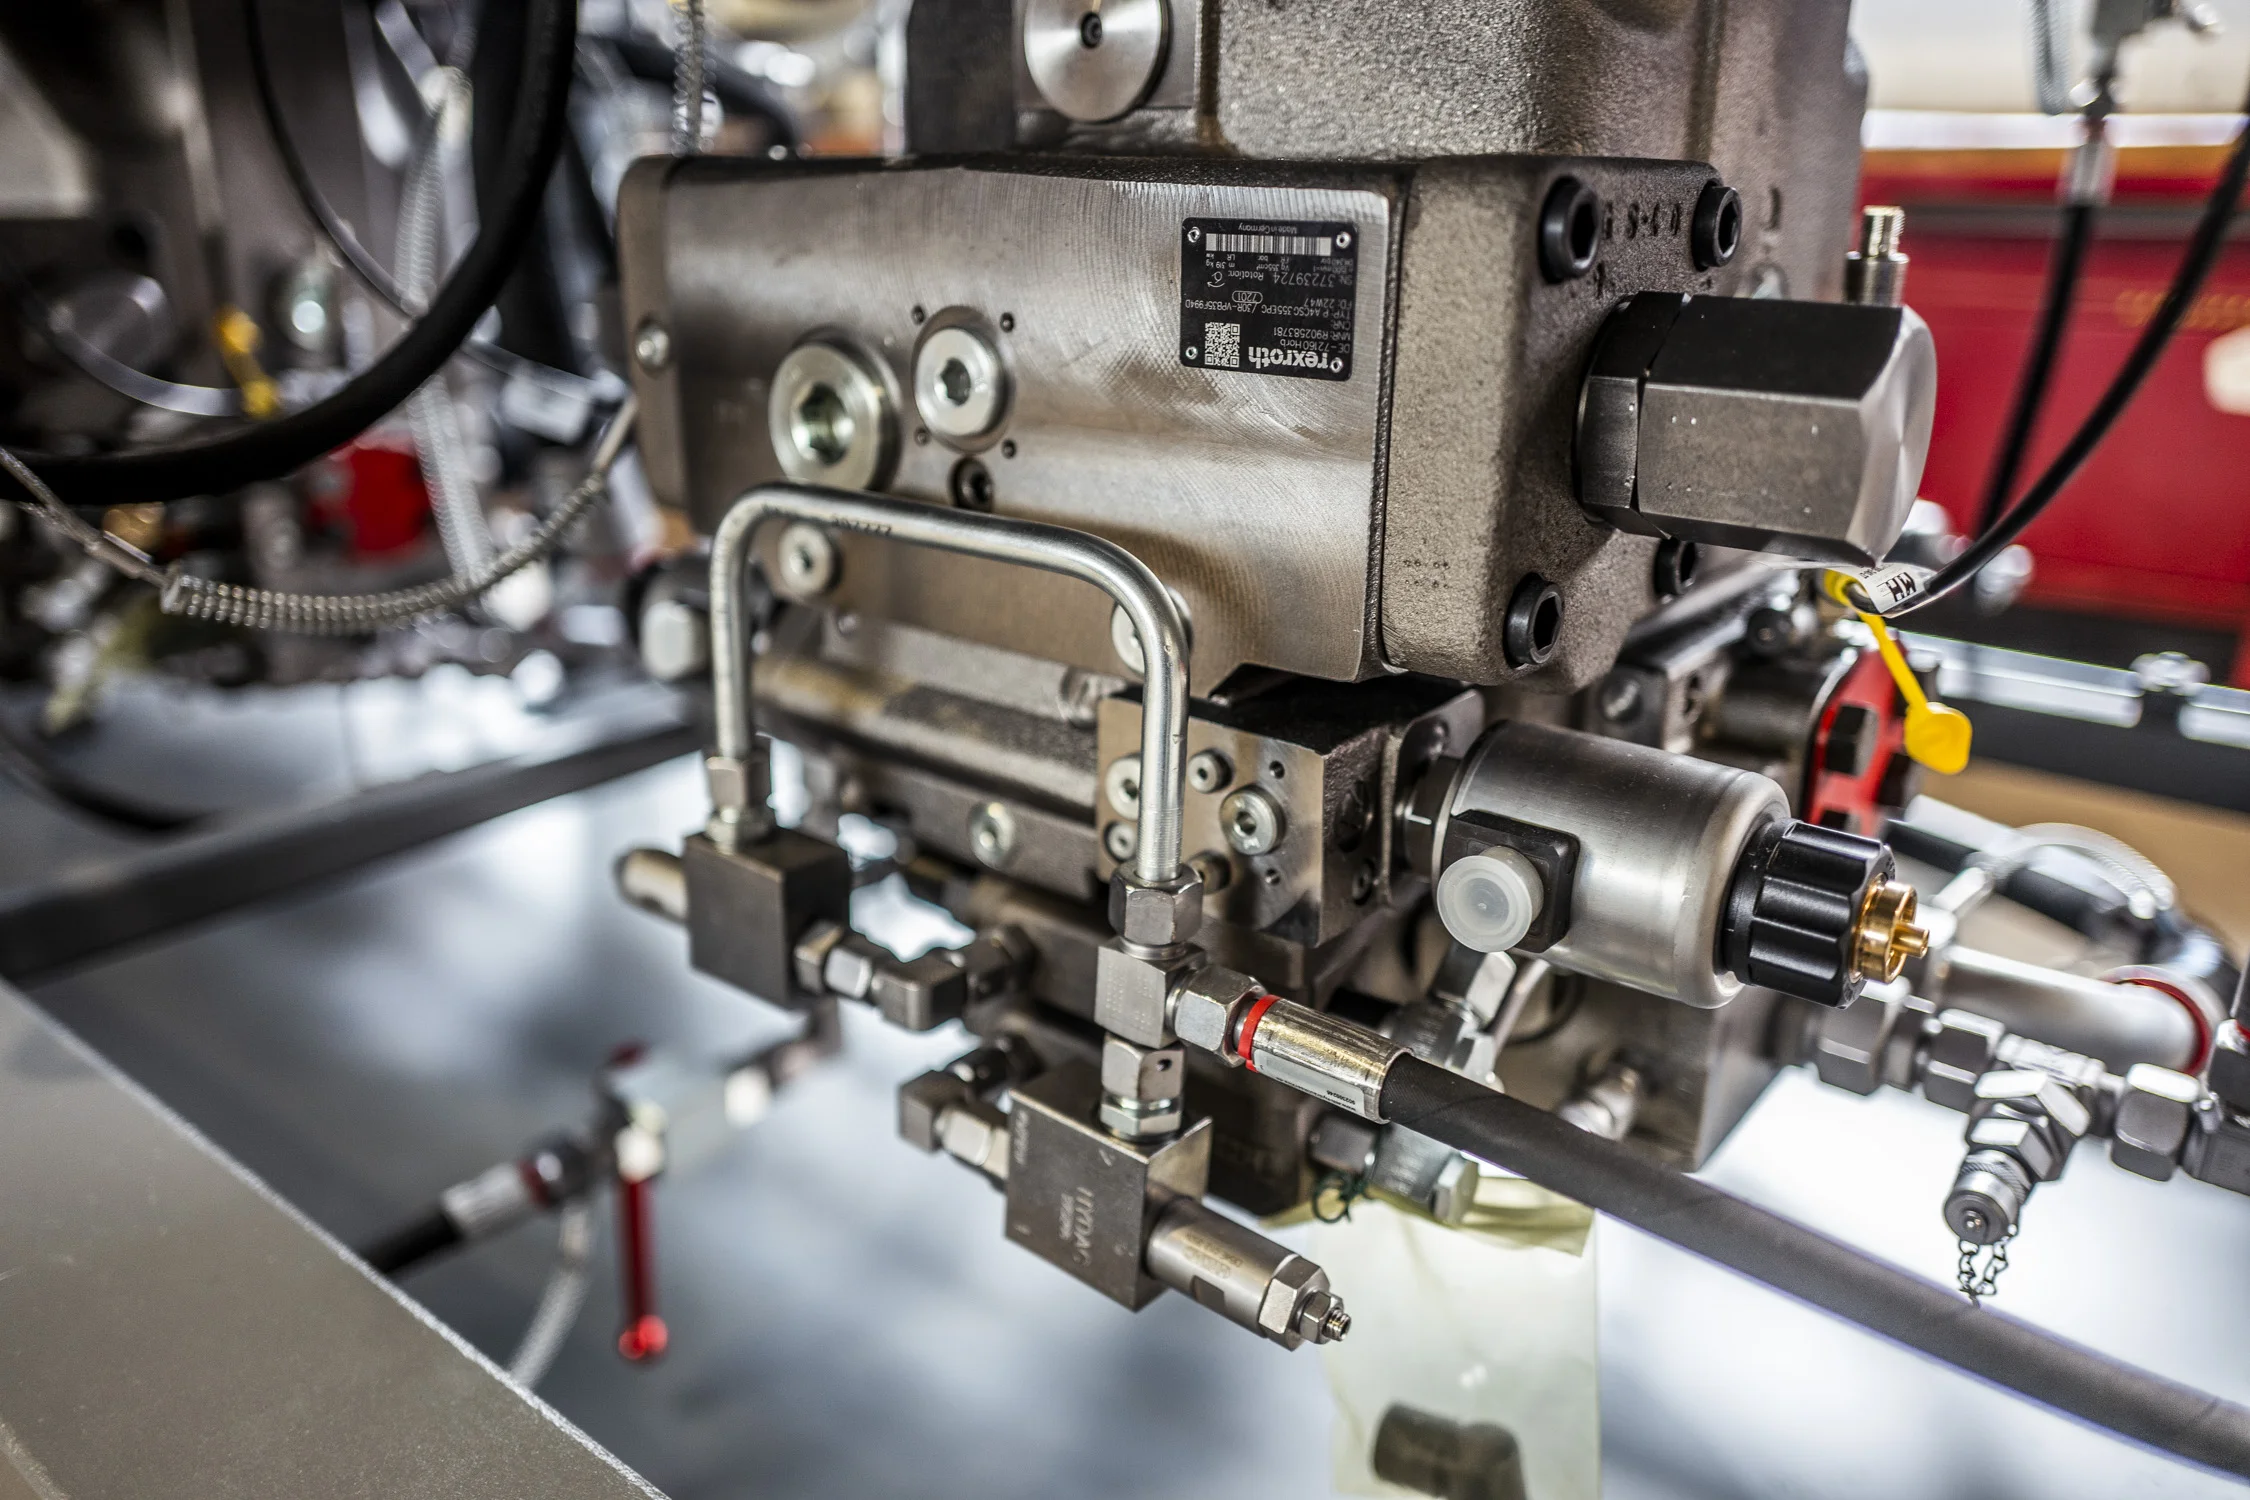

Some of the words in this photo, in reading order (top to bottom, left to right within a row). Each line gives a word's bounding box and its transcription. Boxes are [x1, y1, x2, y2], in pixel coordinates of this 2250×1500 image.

[1238, 223, 1270, 234] Germany
[1277, 226, 1297, 234] Made
[1206, 259, 1213, 267] kg
[1228, 270, 1264, 281] Rotation:
[1273, 272, 1336, 288] 37239724
[1304, 298, 1335, 309] 22W47
[1331, 320, 1351, 330] CNR:
[1273, 327, 1328, 340] R902583781
[1330, 331, 1350, 340] MNR:
[1280, 338, 1301, 348] Horb
[1248, 346, 1328, 369] rexroth
